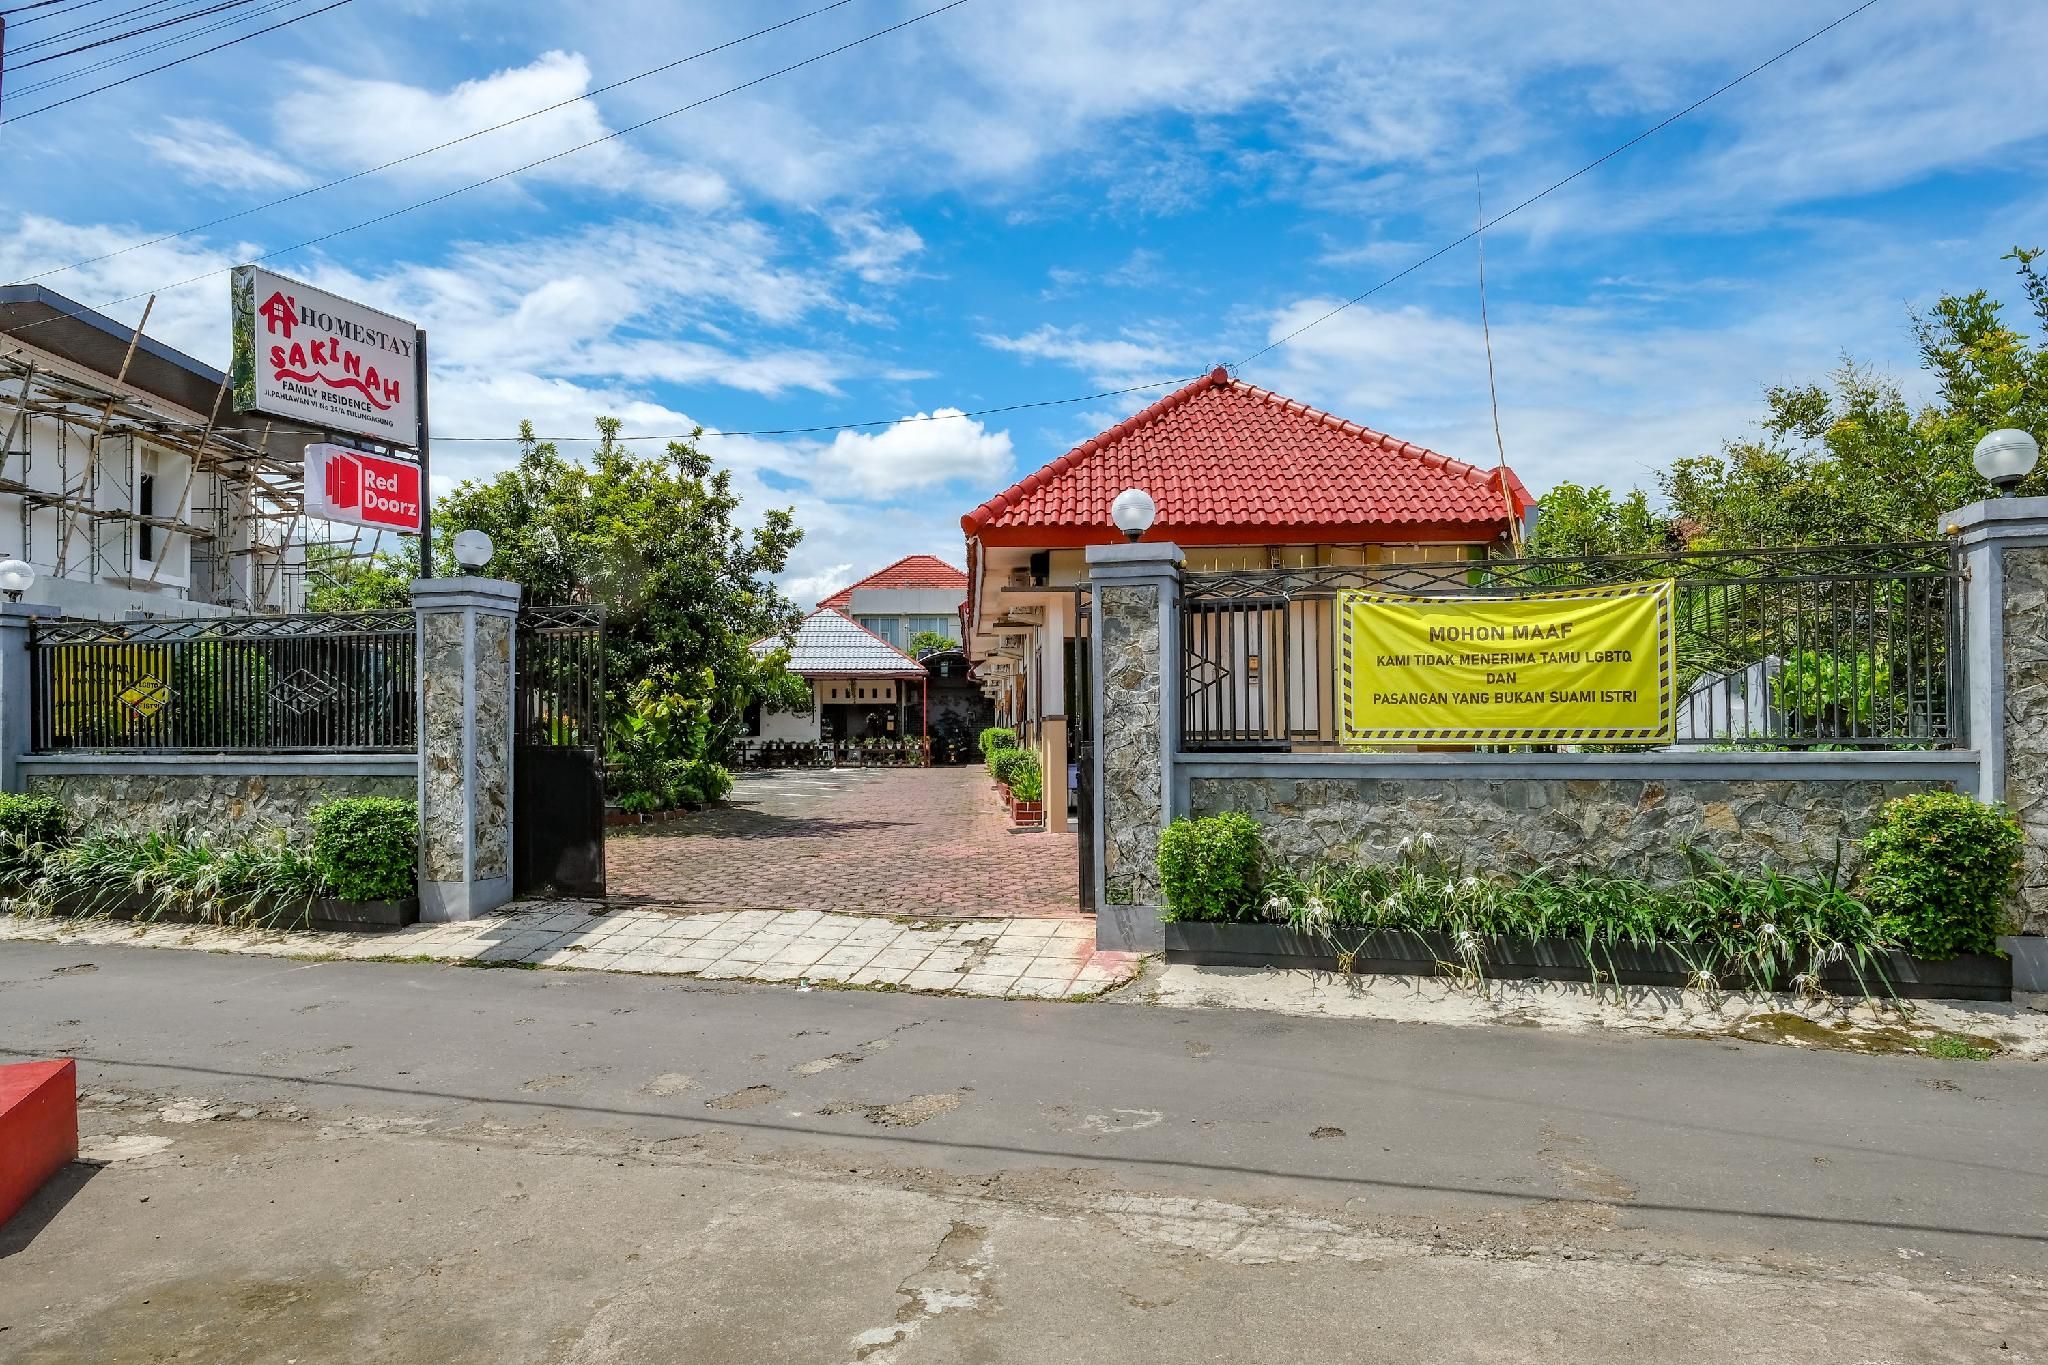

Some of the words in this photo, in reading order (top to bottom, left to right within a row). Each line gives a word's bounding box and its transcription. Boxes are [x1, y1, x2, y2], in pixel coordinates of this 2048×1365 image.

[299, 305, 412, 358] HOMESTAY
[269, 336, 400, 403] SAKINAH
[282, 380, 318, 399] FAMILY
[321, 390, 372, 413] RESIDENCE
[364, 469, 398, 493] Red
[364, 489, 417, 517] Doorz
[1429, 626, 1505, 642] MOHON
[1512, 622, 1573, 641] MAAF
[1376, 654, 1410, 667] KAMI
[1413, 654, 1455, 666] TIDAK
[1459, 652, 1537, 666] MENERIMA
[1539, 651, 1581, 664] TAMU
[1585, 650, 1633, 663] LGBTQ
[1486, 672, 1517, 685] DAN
[1373, 692, 1448, 705] PASANGAN
[1451, 692, 1490, 705] YANG
[1494, 691, 1545, 704] BUKAN
[1549, 690, 1596, 703] SUAMI
[1600, 690, 1637, 703] ISTRI
